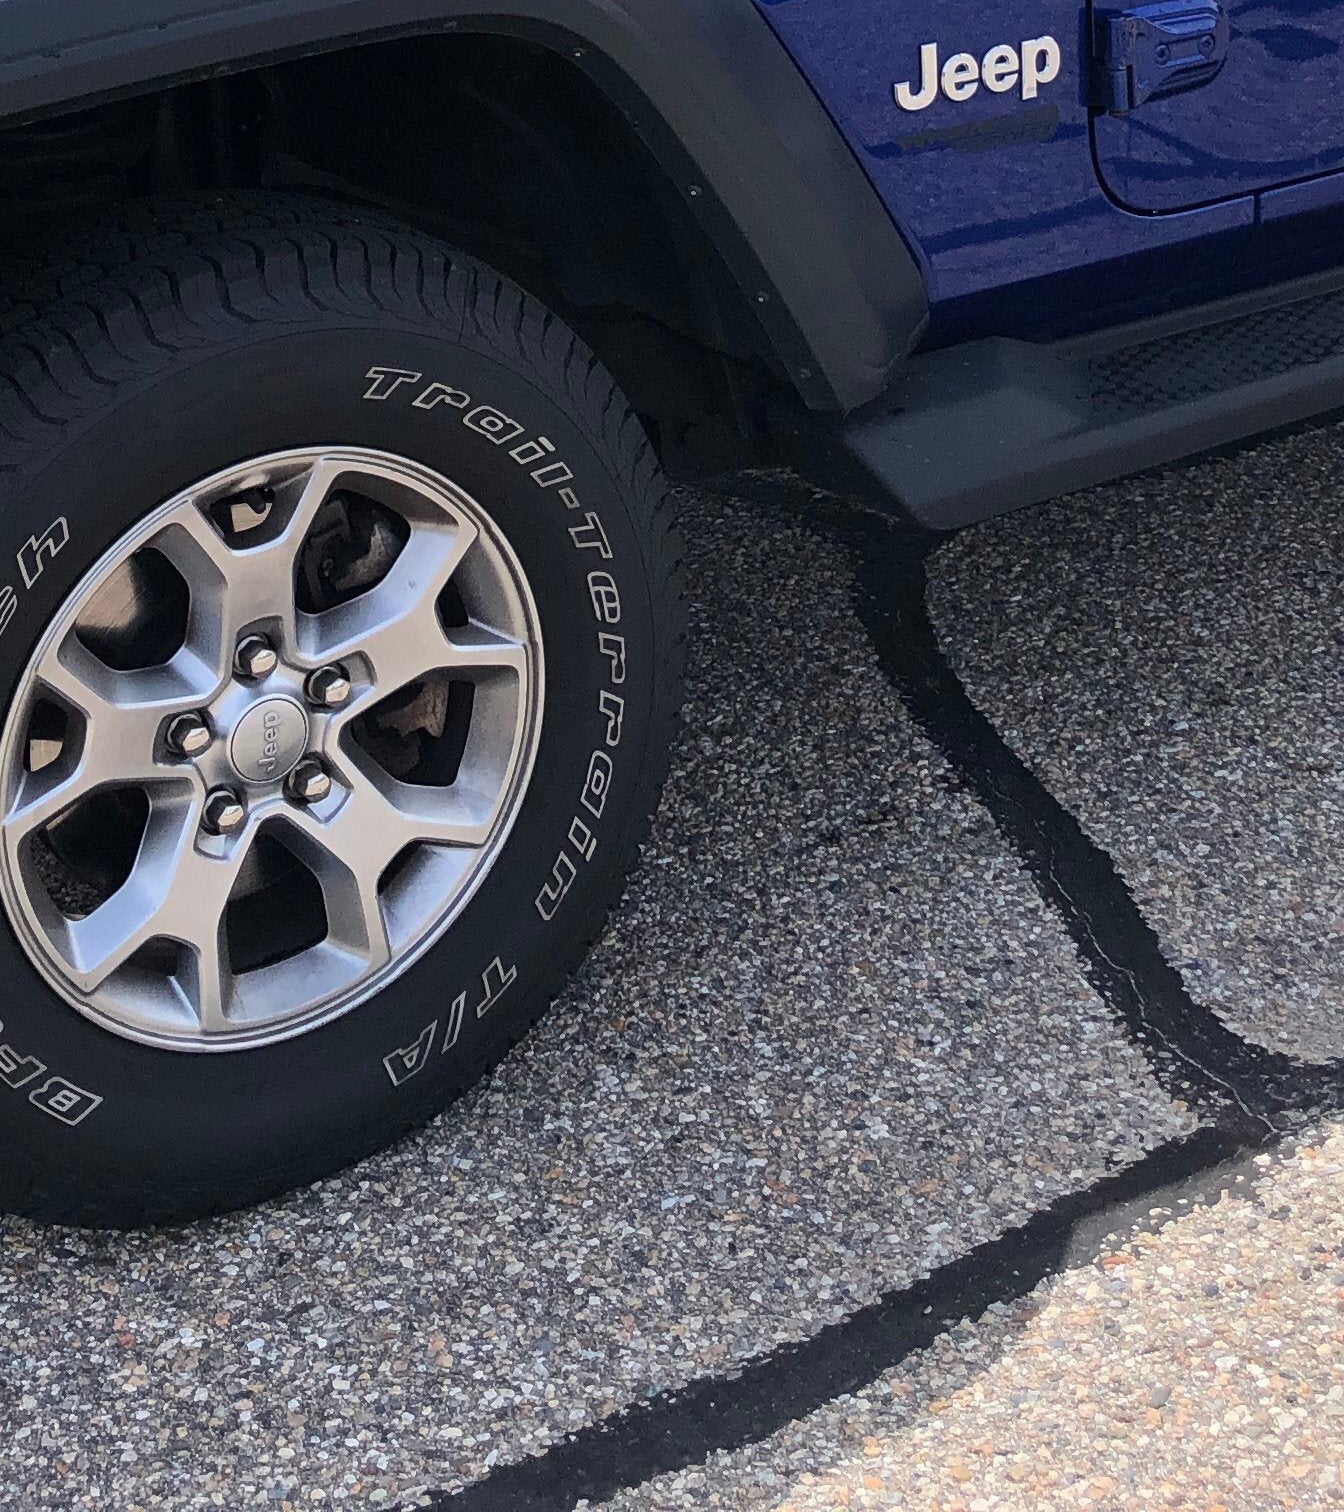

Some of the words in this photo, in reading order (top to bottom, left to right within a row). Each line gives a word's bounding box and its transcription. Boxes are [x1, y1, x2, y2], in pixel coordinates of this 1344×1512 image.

[893, 35, 1061, 111] Jeep
[362, 365, 626, 921] Trail-Terrain
[257, 710, 281, 774] Jeep
[382, 955, 518, 1087] T/A
